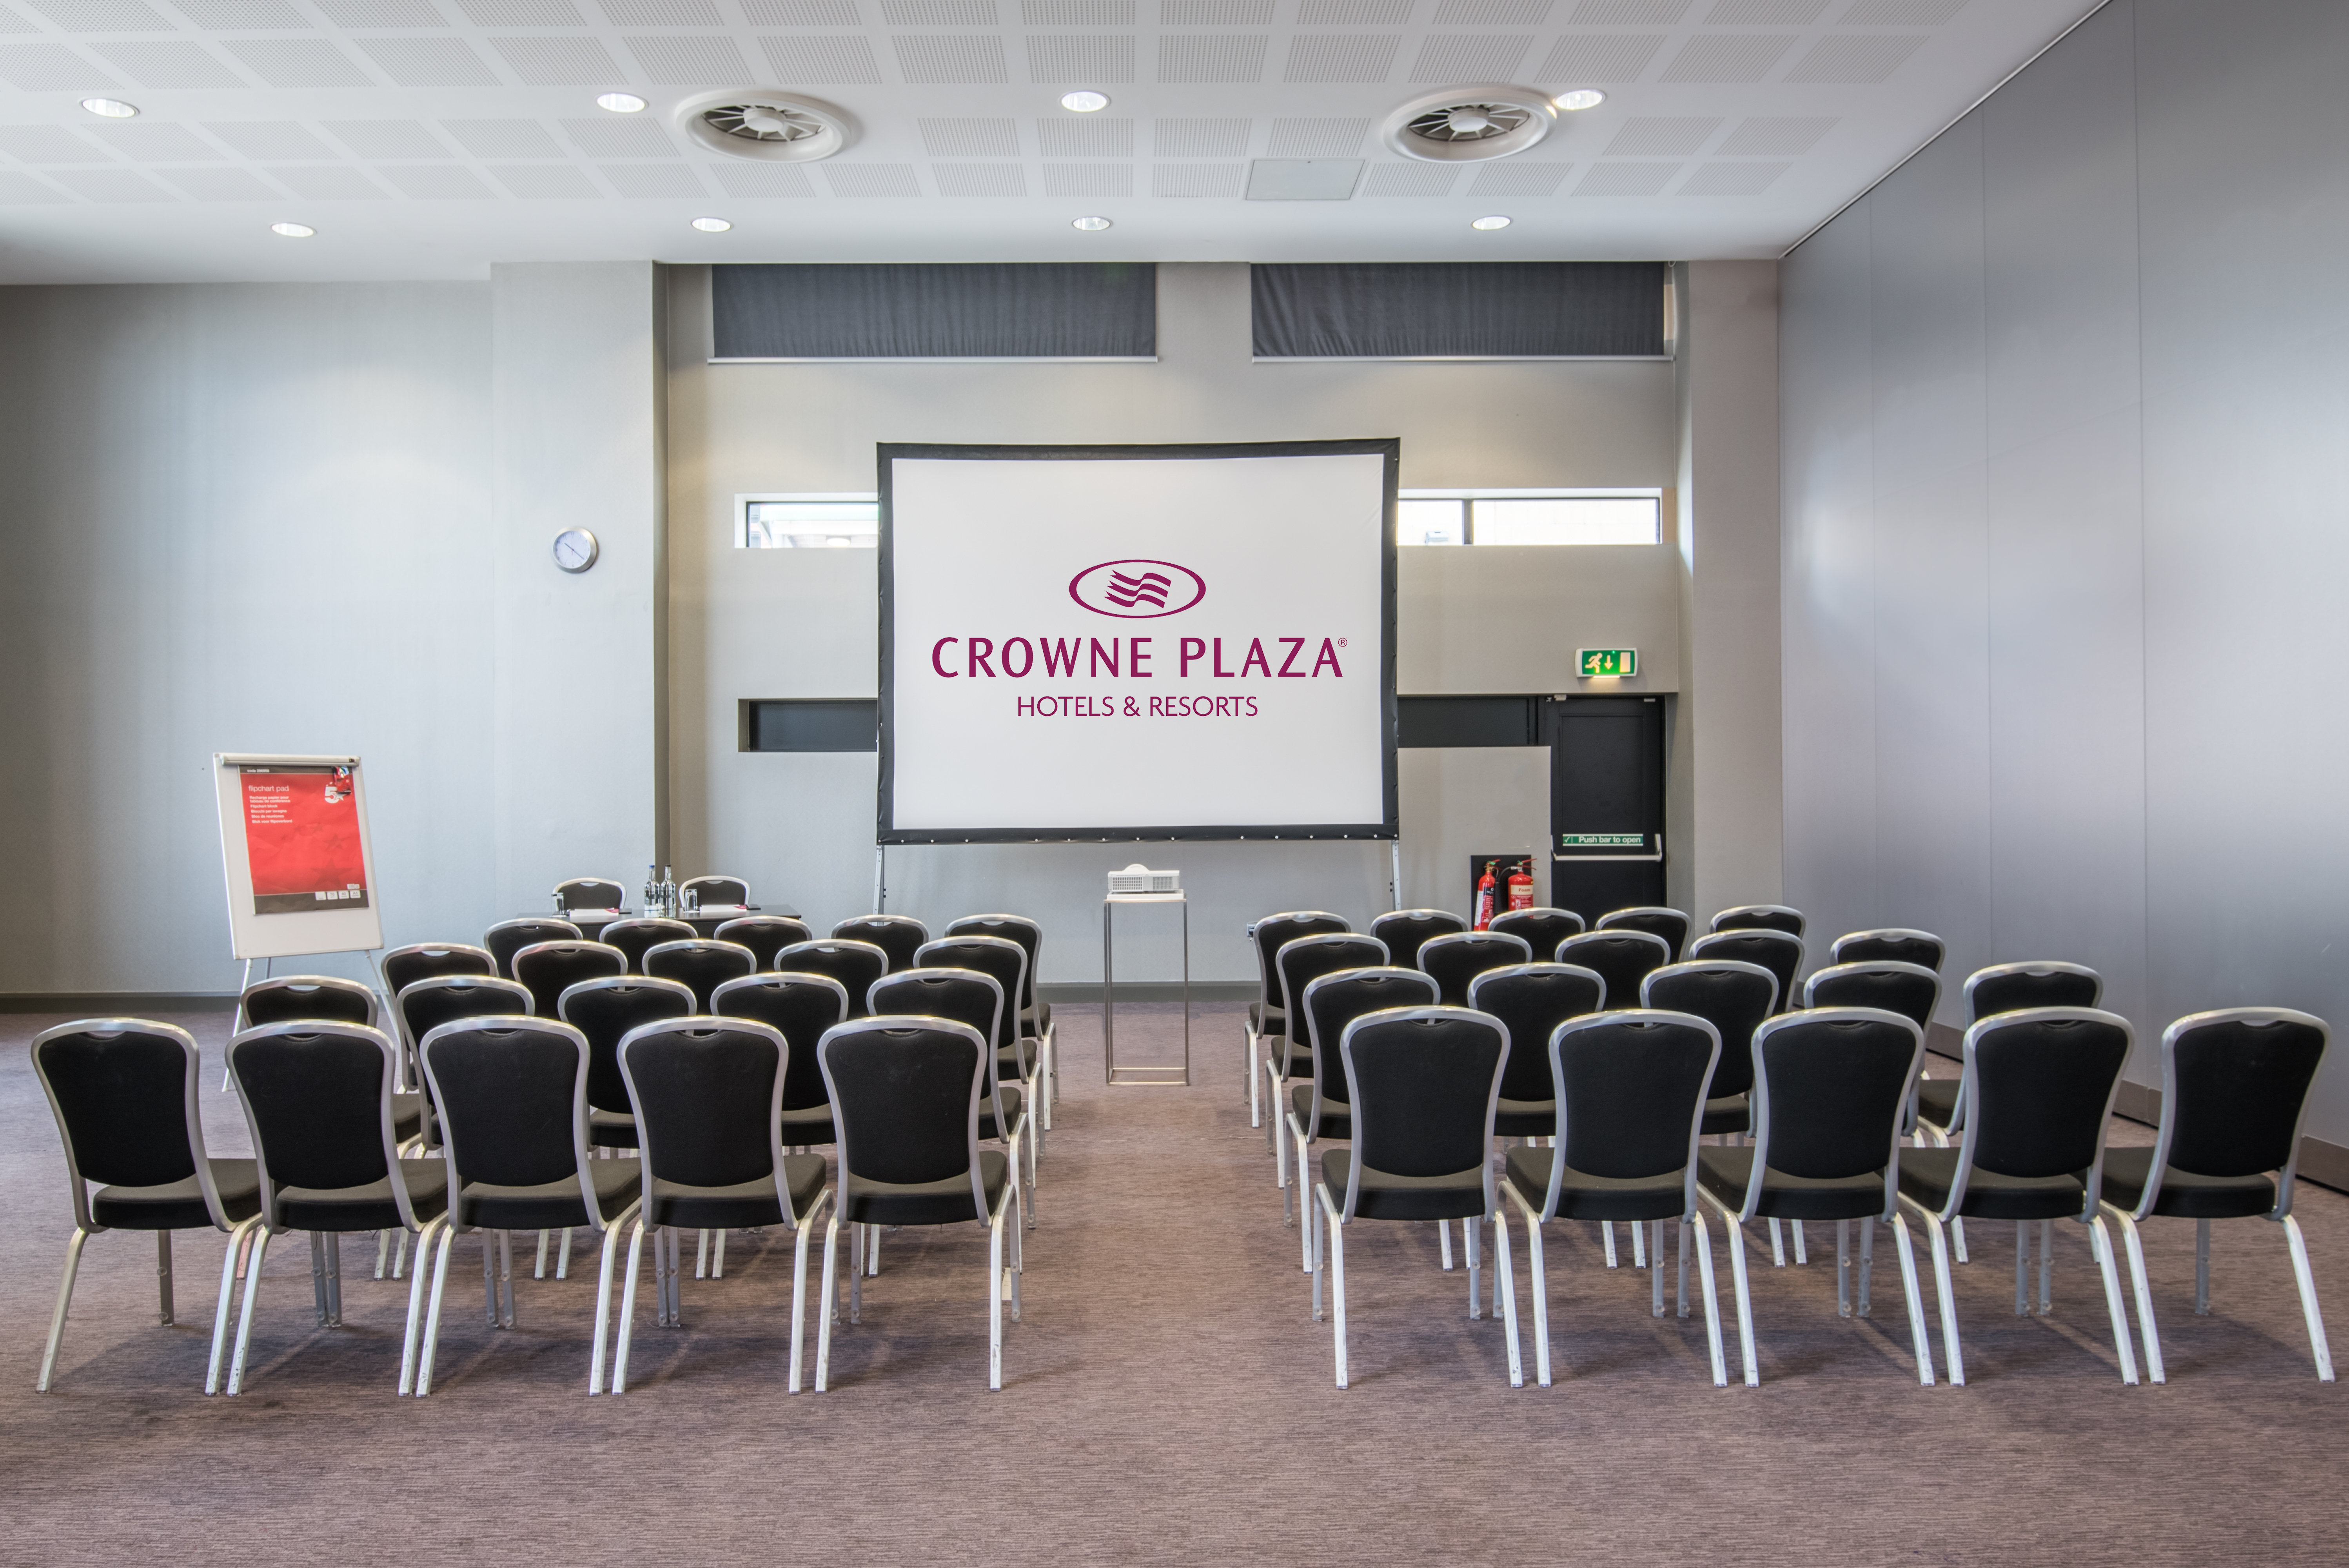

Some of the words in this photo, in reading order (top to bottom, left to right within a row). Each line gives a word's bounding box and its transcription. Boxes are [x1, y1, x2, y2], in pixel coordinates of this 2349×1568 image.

[932, 637, 1152, 678] CROWNE
[1018, 696, 1114, 717] HOTELS
[1123, 696, 1141, 717] &
[1150, 696, 1258, 717] RESORTS
